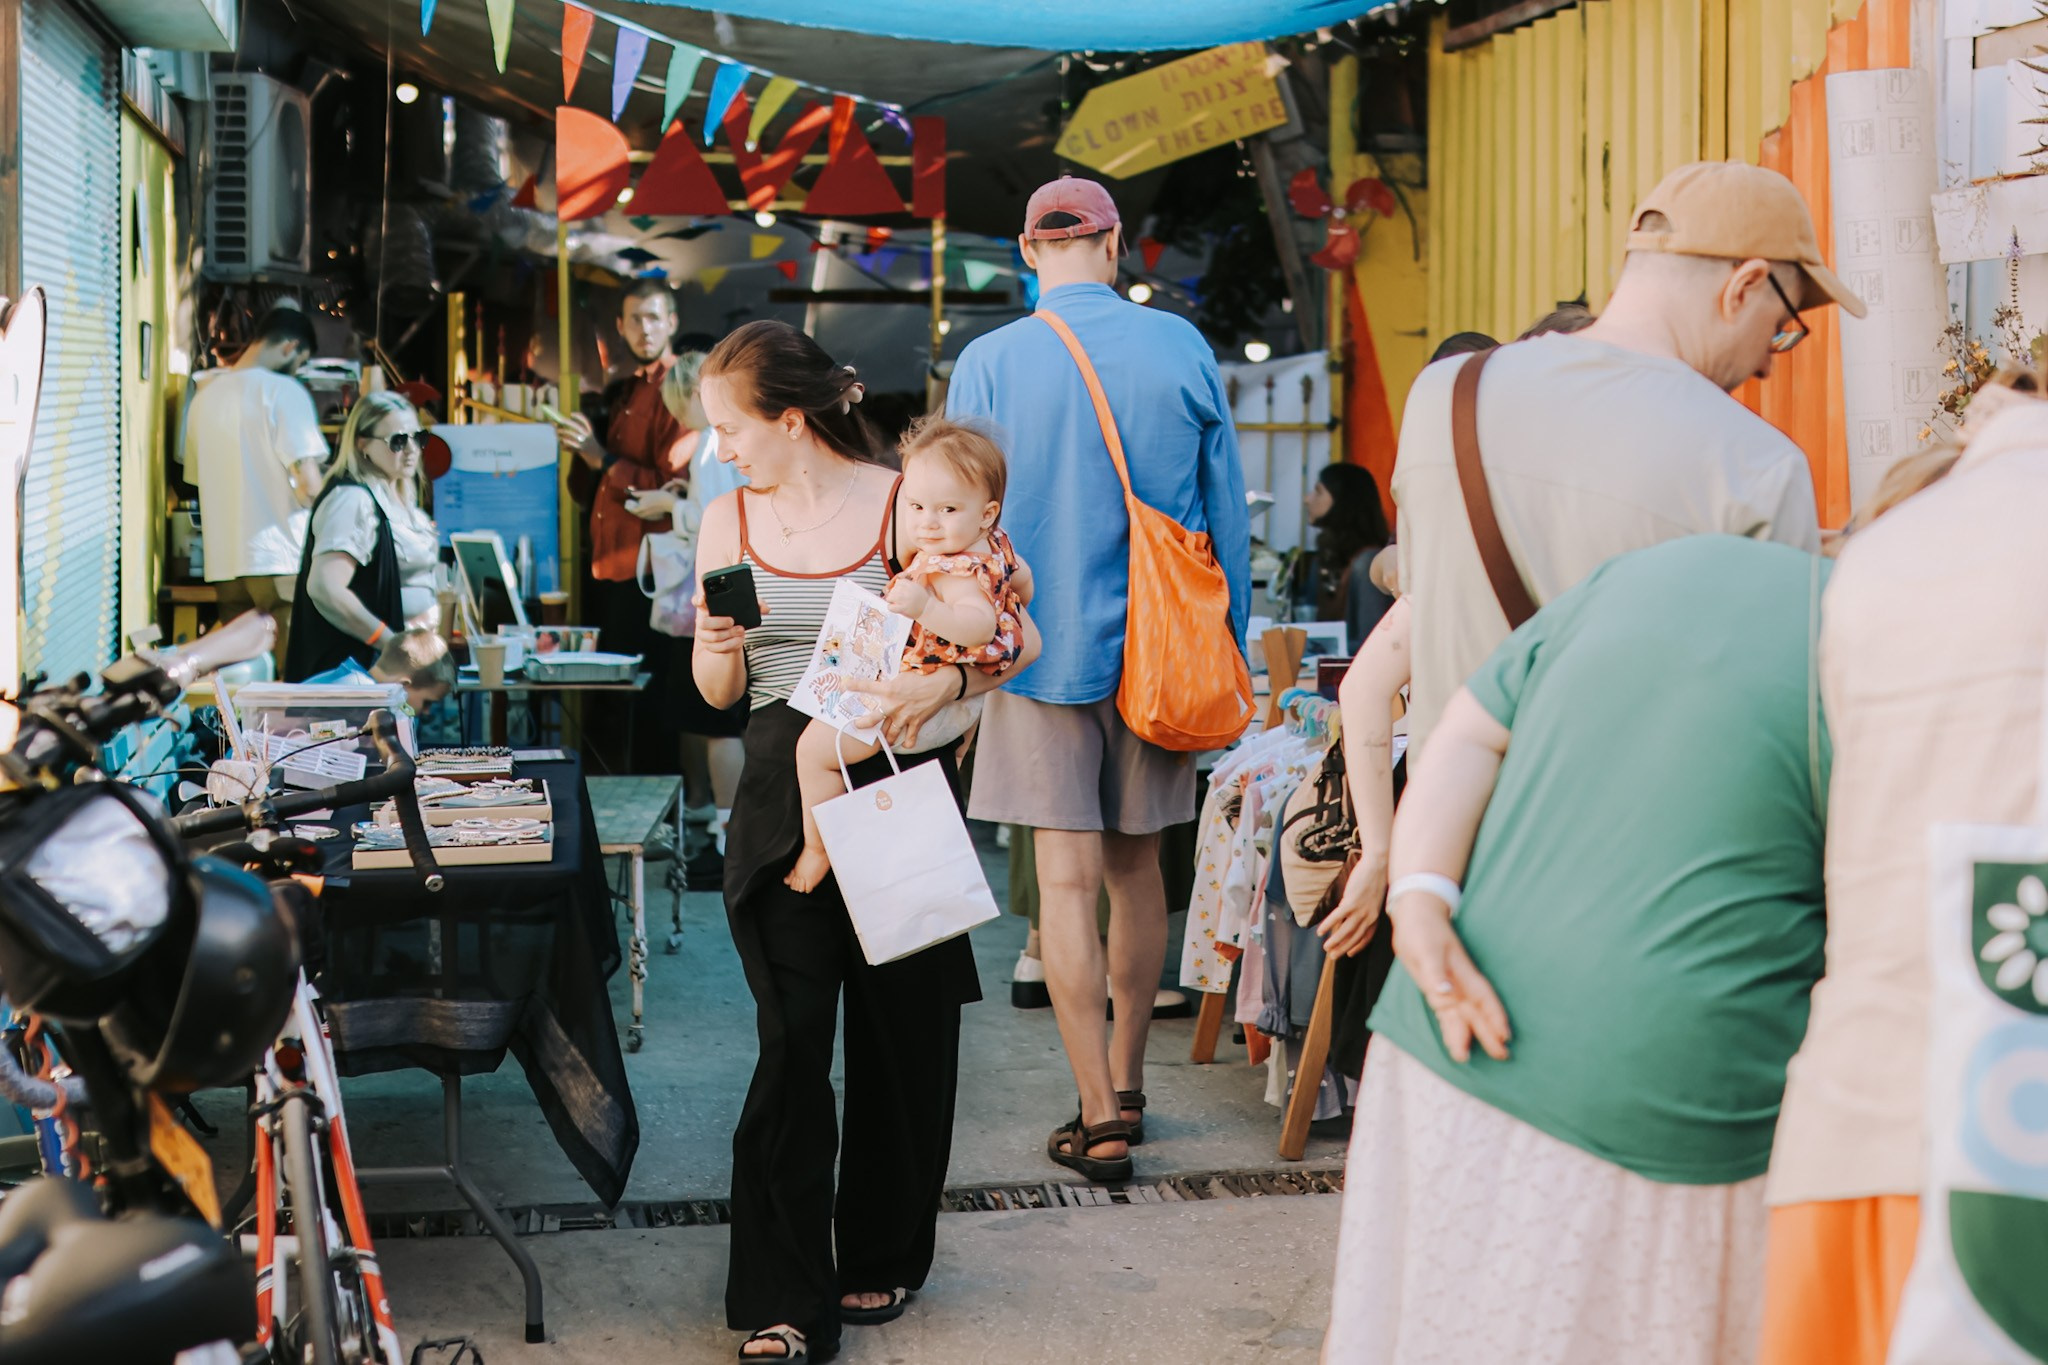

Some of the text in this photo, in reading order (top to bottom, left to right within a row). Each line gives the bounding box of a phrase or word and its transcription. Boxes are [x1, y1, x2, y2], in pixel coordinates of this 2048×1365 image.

[1066, 106, 1160, 156] CLOWN
[1156, 97, 1286, 154] THEATRE
[556, 91, 945, 221] DAVAI
